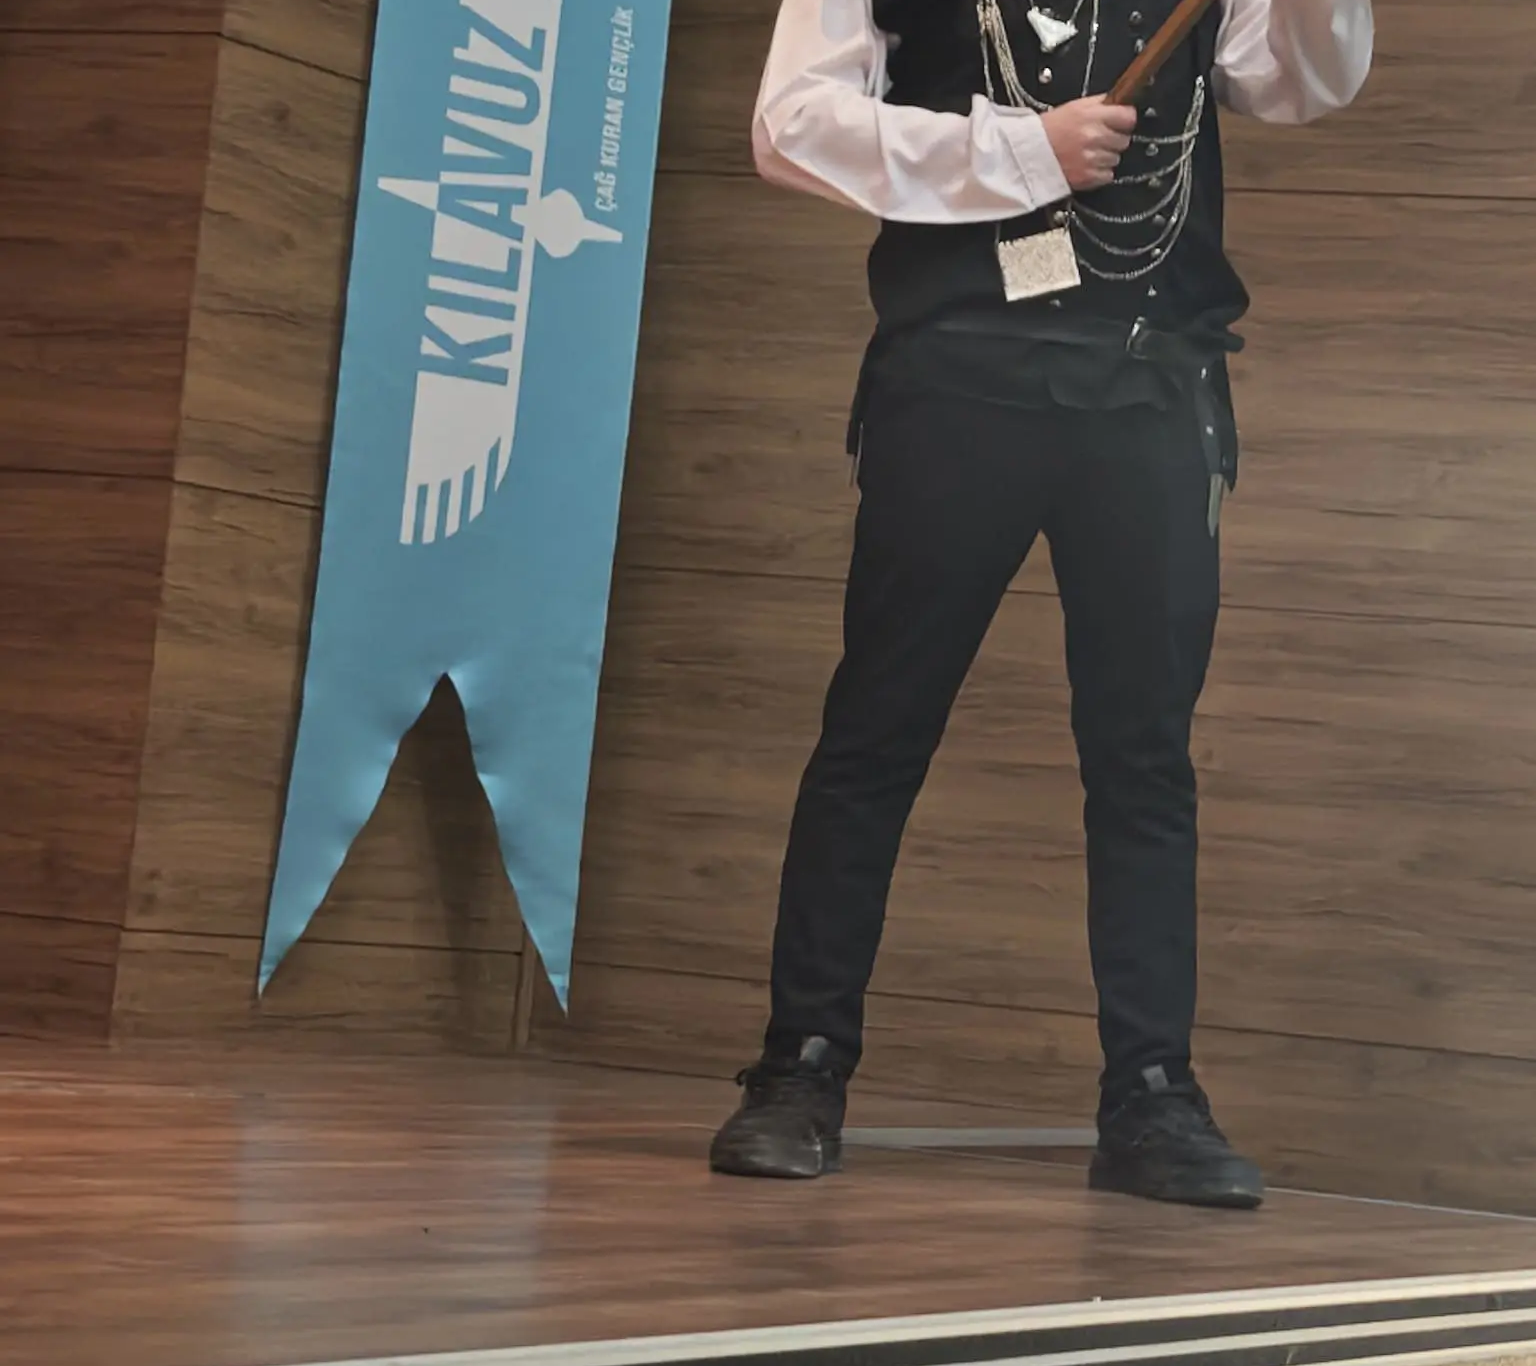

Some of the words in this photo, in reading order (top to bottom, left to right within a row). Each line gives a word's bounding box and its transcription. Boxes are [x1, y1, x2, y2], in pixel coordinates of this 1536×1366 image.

[608, 6, 634, 93] GENÇLİK
[601, 97, 624, 167] KURAN
[417, 4, 547, 386] KILAVUZ
[594, 171, 618, 212] ÇAĞ
